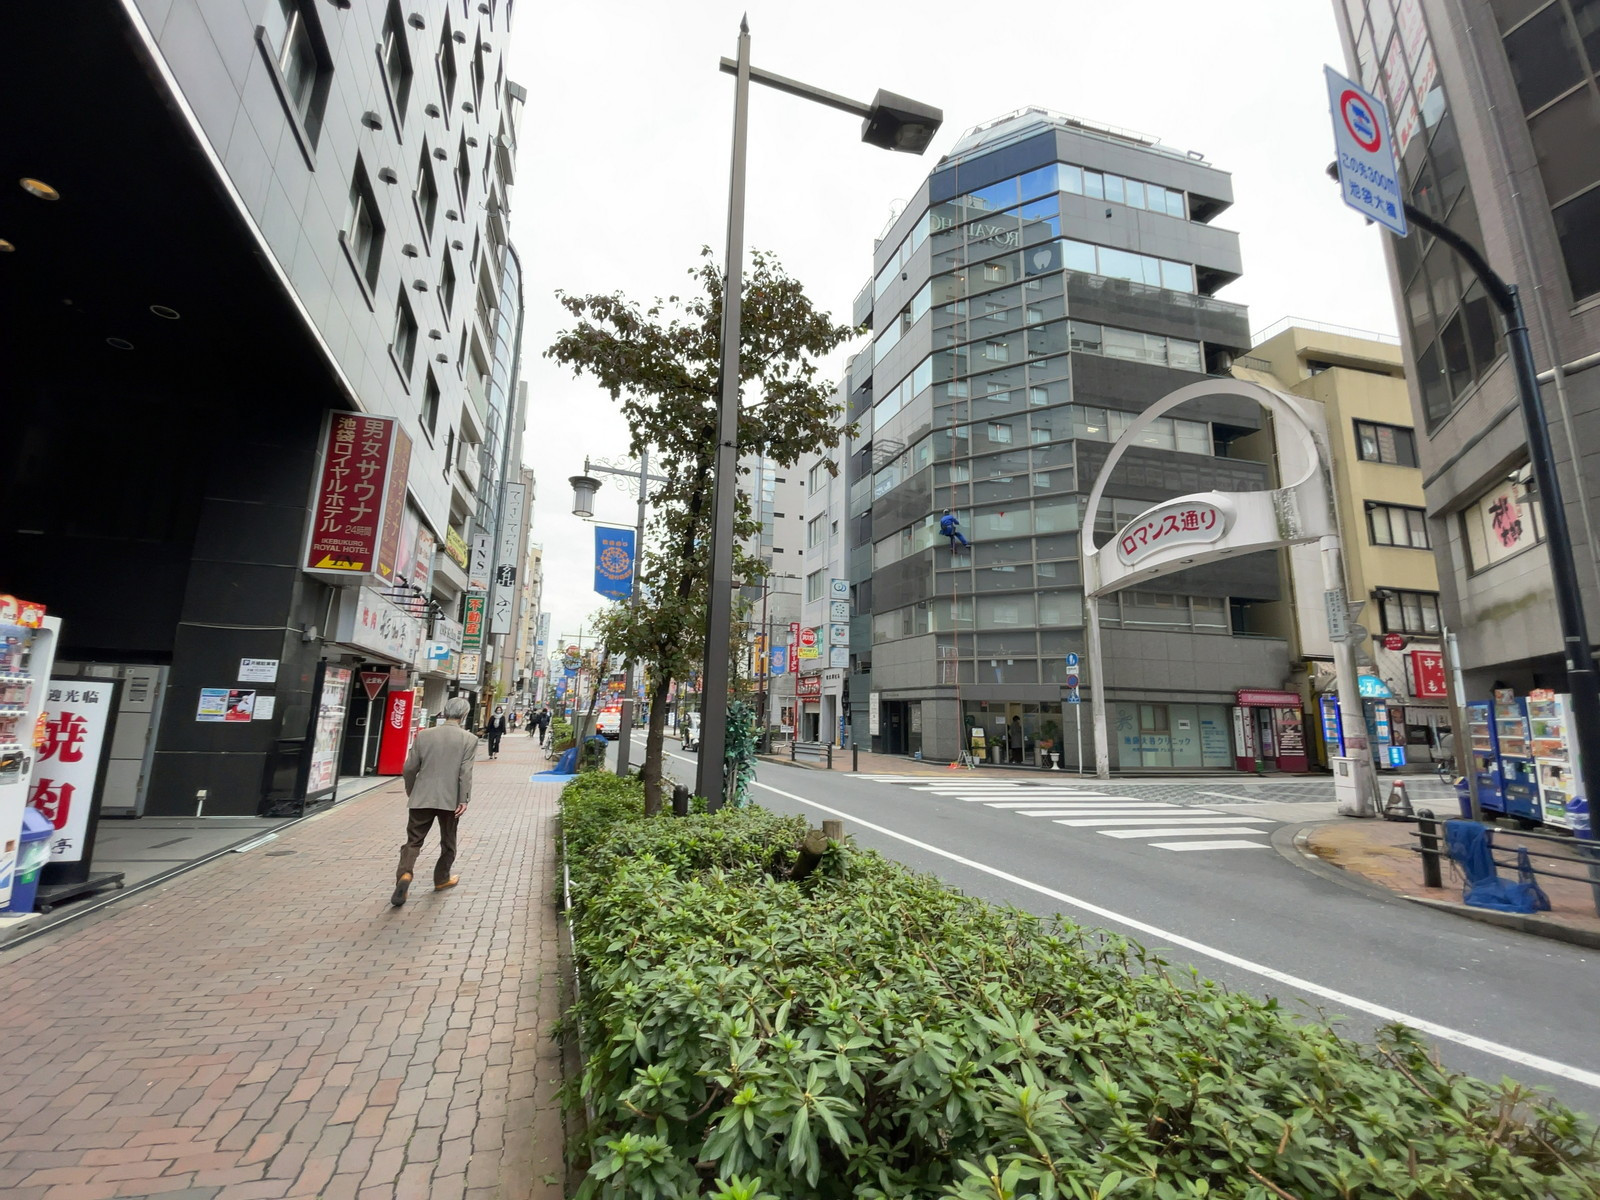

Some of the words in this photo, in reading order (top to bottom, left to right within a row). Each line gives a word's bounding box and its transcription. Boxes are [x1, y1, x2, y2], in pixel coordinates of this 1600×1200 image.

[320, 417, 357, 533] 池袋ロイヤルホテル
[349, 419, 385, 523] 男女サウナ
[321, 538, 363, 547] IKEBUKURO
[344, 524, 373, 537] 24時間
[1121, 509, 1216, 555] ロマンス通り
[313, 543, 342, 552] ROYAL
[342, 545, 370, 555] HOTEL
[476, 539, 485, 571] INS
[465, 599, 482, 635] 不動産
[496, 596, 511, 622] ふぐ
[391, 699, 407, 730] Coca-Cola
[27, 711, 88, 831] 焼肉
